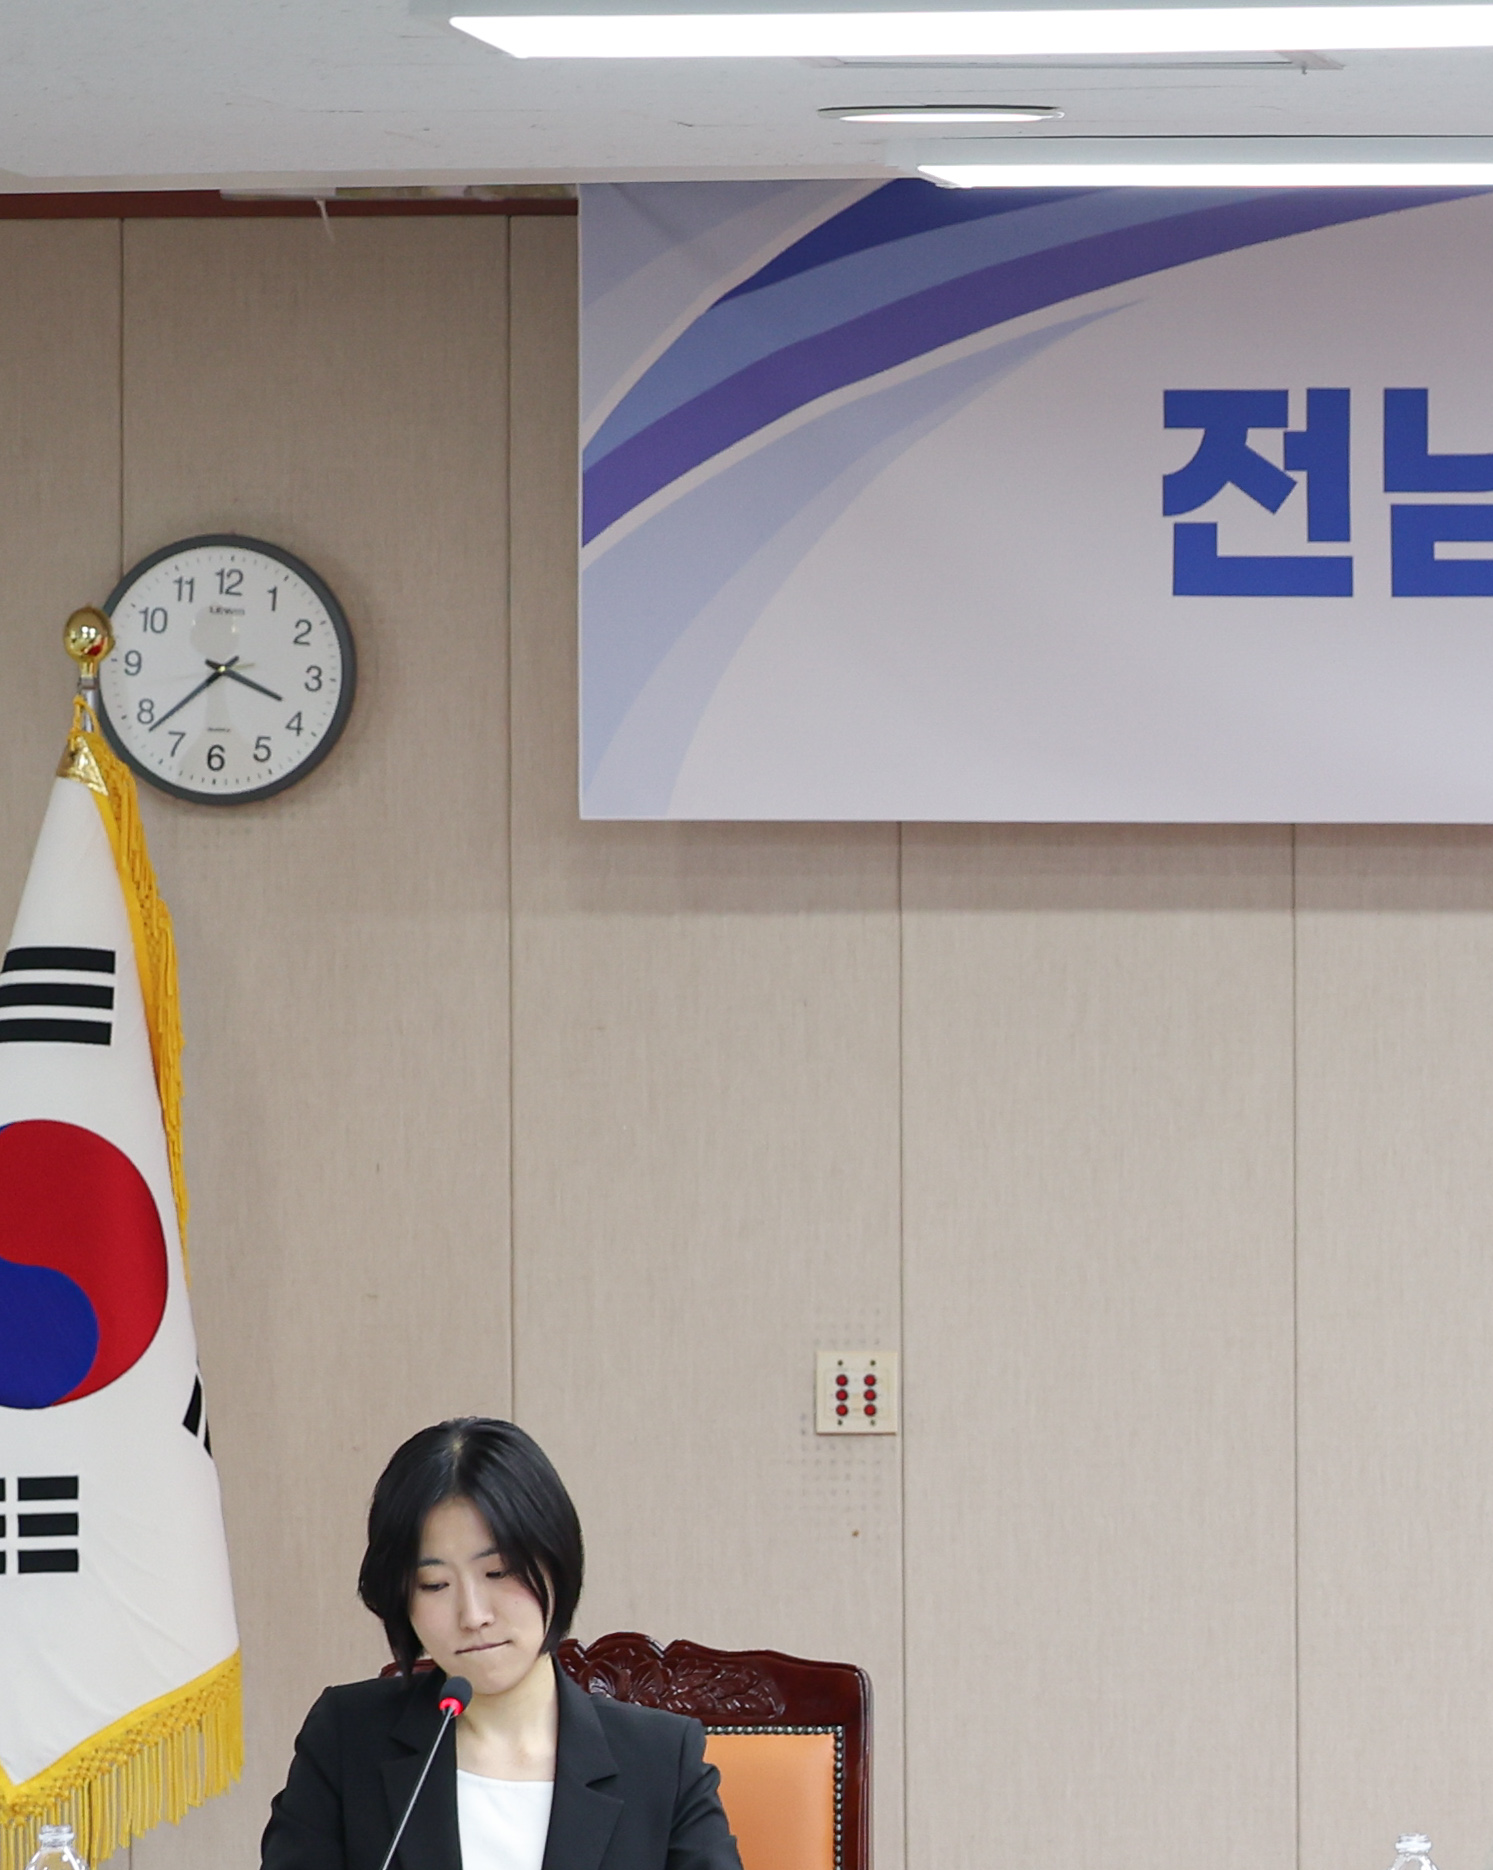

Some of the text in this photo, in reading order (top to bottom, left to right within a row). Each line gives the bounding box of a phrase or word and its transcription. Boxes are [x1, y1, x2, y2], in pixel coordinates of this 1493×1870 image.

[174, 577, 195, 602] 11
[215, 569, 244, 596] 12
[268, 587, 278, 611] 1
[139, 607, 168, 633] 10
[293, 620, 312, 645] 2
[124, 650, 142, 676] 9
[304, 666, 323, 692] 3
[136, 699, 155, 725] 8
[285, 711, 304, 736] 4
[168, 731, 187, 757] 7
[253, 737, 272, 762] 5
[207, 745, 226, 771] 6
